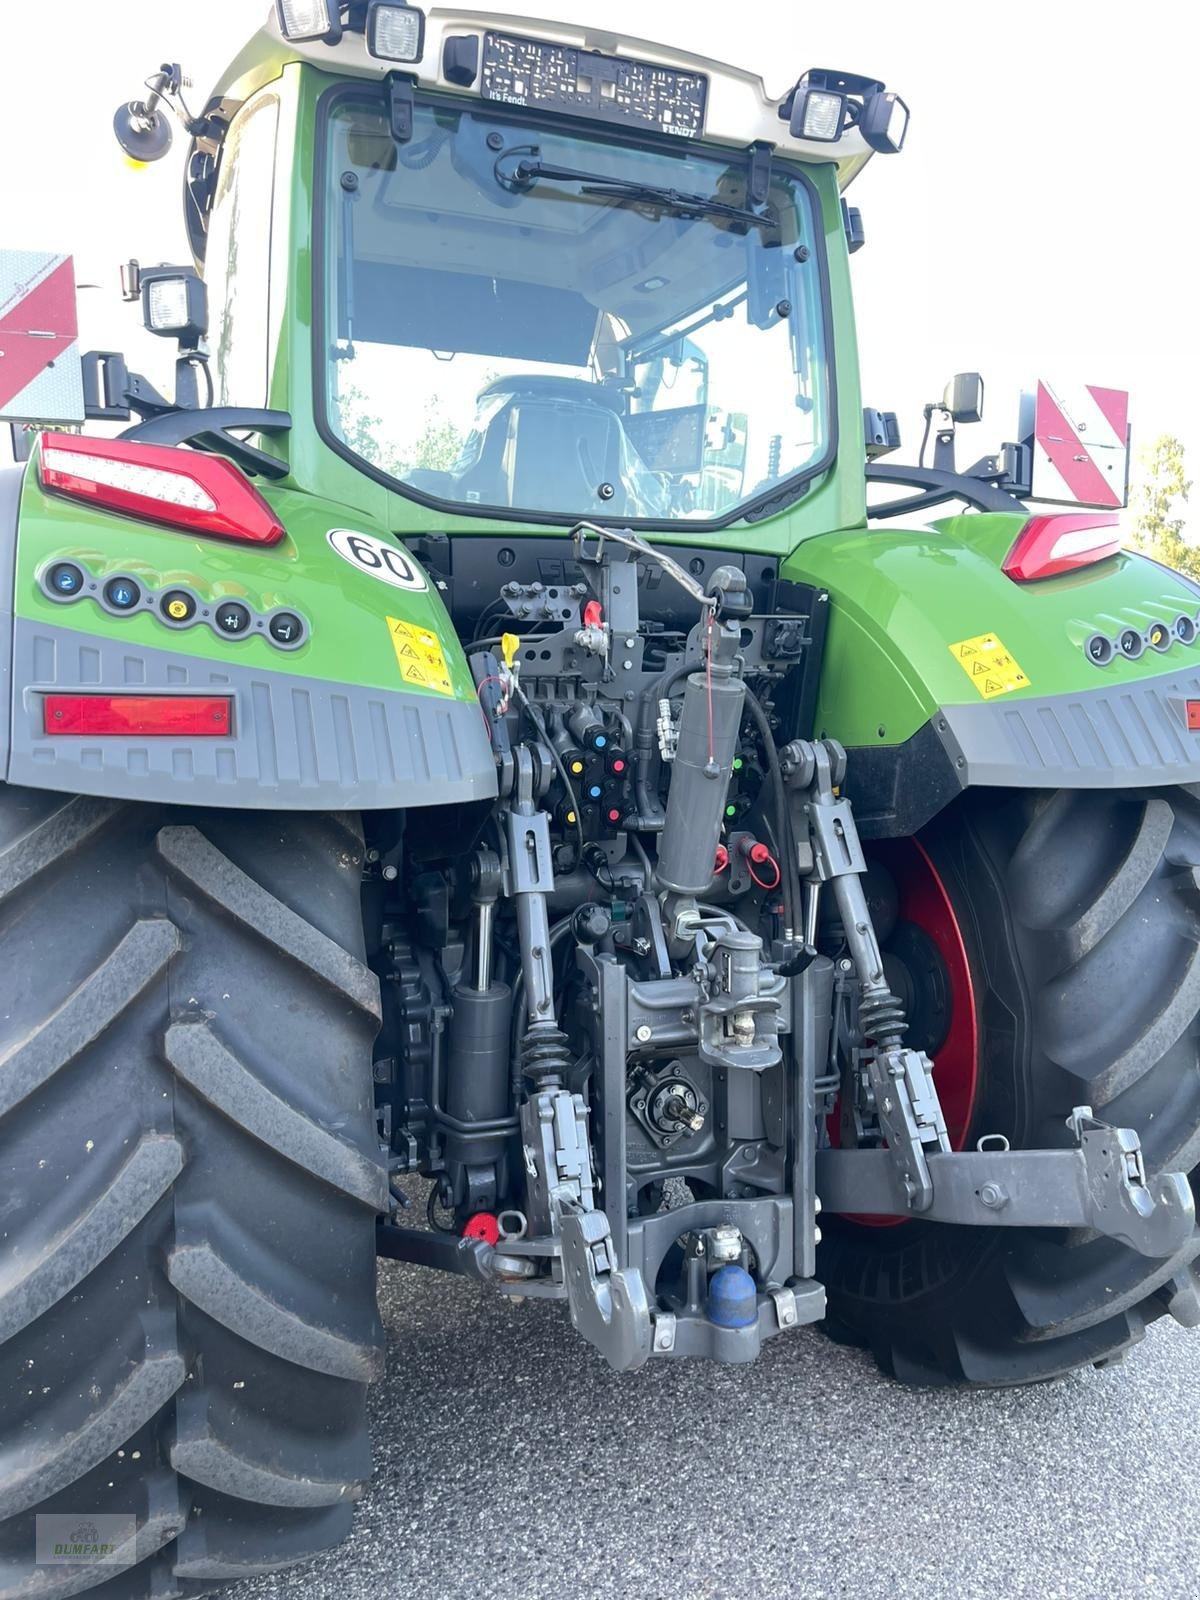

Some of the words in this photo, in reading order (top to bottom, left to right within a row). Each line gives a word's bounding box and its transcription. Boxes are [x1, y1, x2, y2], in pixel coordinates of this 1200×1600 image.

[490, 90, 501, 101] It's
[662, 123, 697, 138] FENDT
[347, 536, 415, 582] 60
